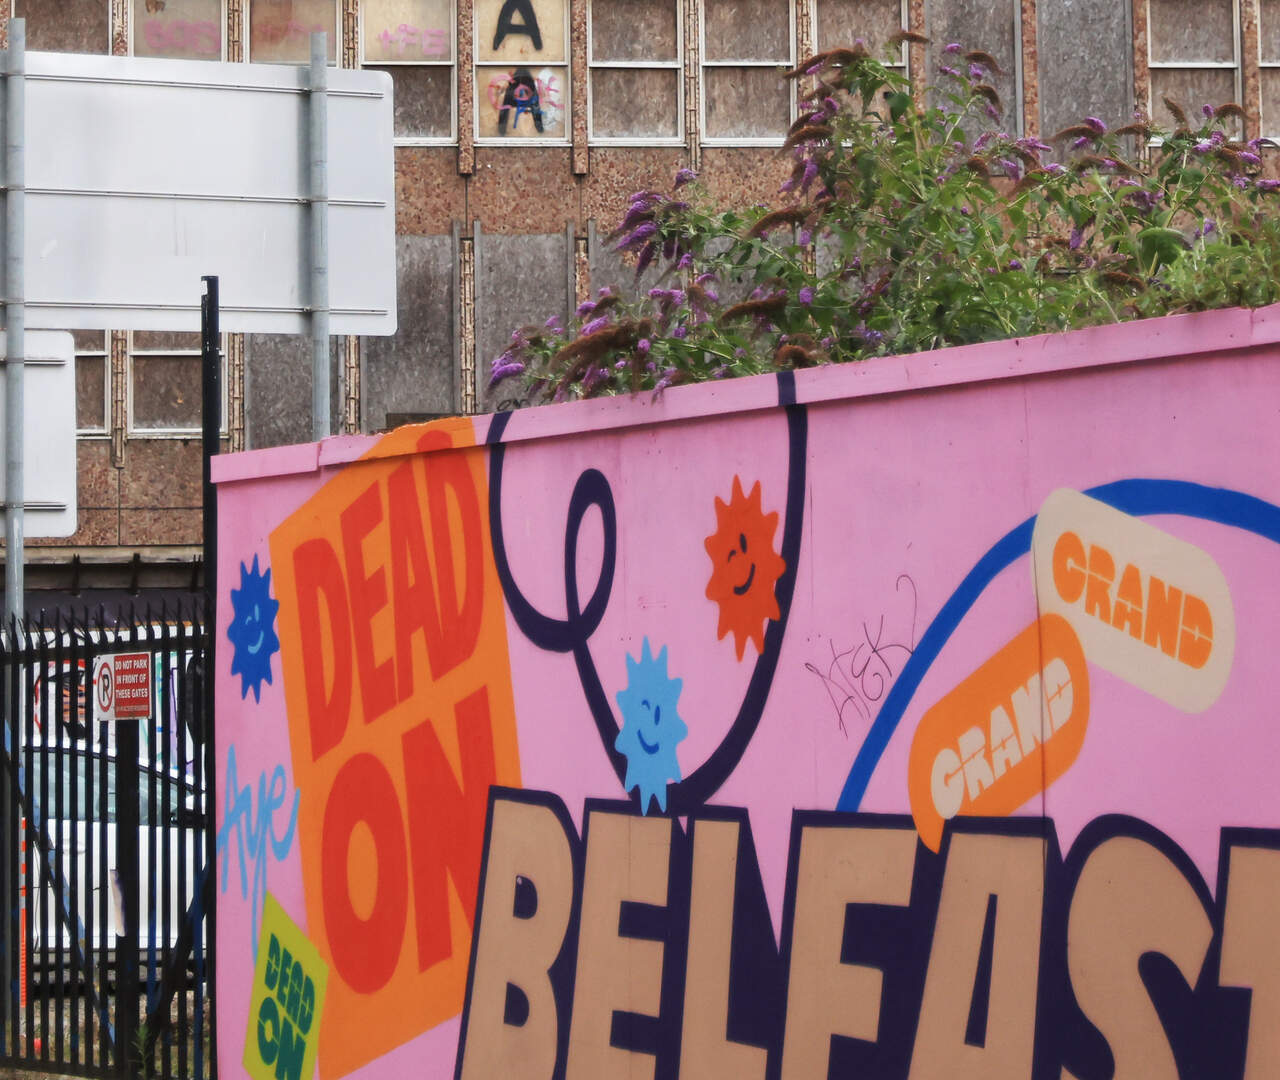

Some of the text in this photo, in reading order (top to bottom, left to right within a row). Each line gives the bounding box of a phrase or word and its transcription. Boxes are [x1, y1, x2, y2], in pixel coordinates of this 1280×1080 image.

[292, 428, 485, 763] DEAD
[1052, 530, 1214, 670] GRAND
[115, 659, 148, 670] DO NOT PARK
[116, 688, 148, 699] THESE GATES
[123, 674, 139, 684] FRONT
[140, 674, 147, 683] OF
[930, 656, 1074, 820] GRAND
[321, 683, 497, 996] ON
[264, 932, 316, 1036] DEAD
[256, 996, 307, 1080] ON
